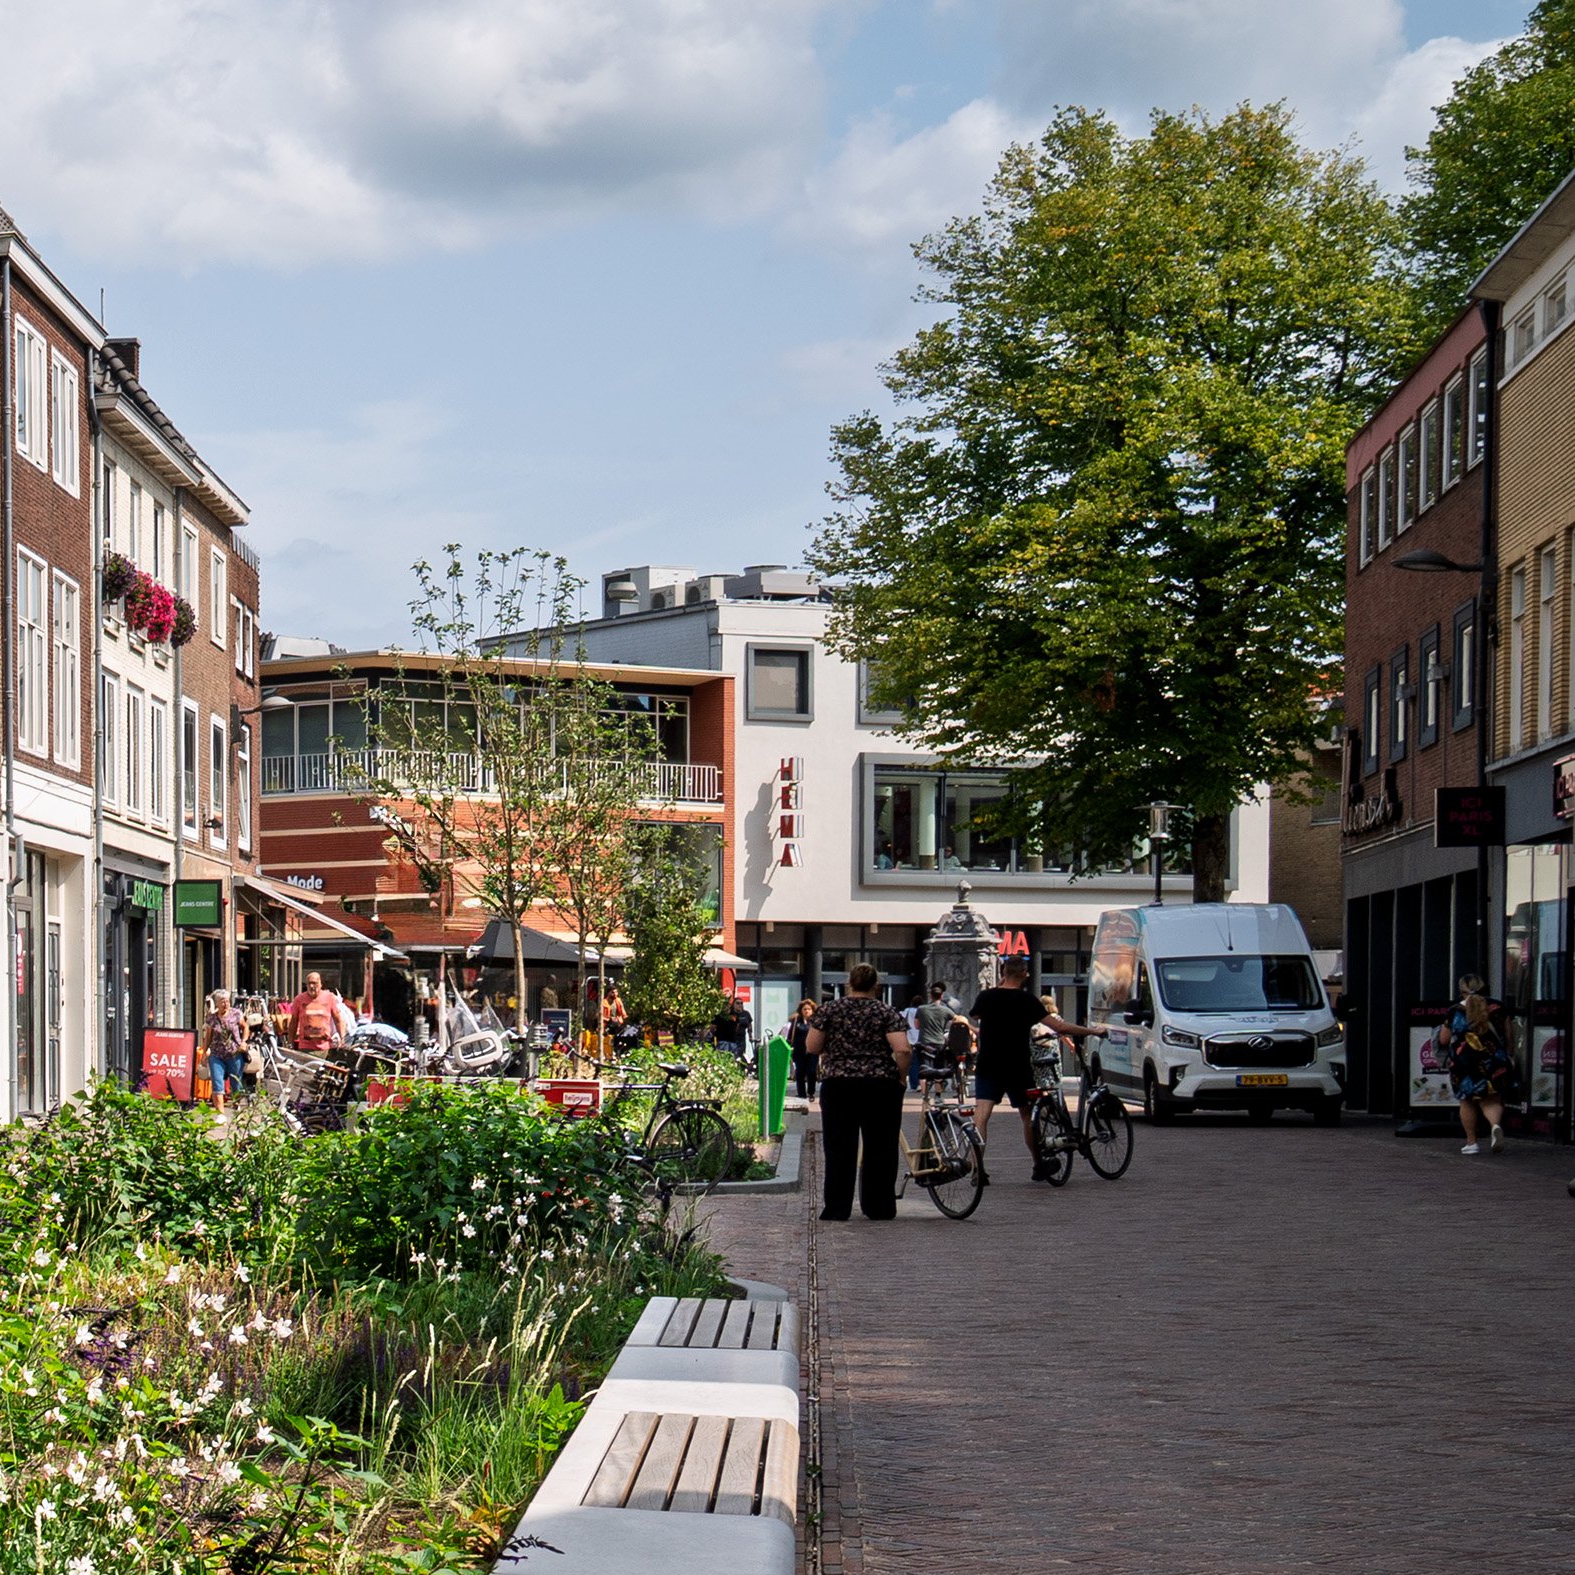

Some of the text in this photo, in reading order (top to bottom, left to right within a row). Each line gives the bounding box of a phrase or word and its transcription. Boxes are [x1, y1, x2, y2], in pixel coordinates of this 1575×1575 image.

[1460, 798, 1483, 808] ICI
[779, 756, 800, 868] HEMA
[1450, 811, 1494, 822] PARIS
[1462, 825, 1481, 836] XL
[287, 875, 323, 890] Mode
[996, 931, 1030, 955] MA
[150, 1053, 187, 1068] SALE
[166, 1068, 186, 1078] 70%
